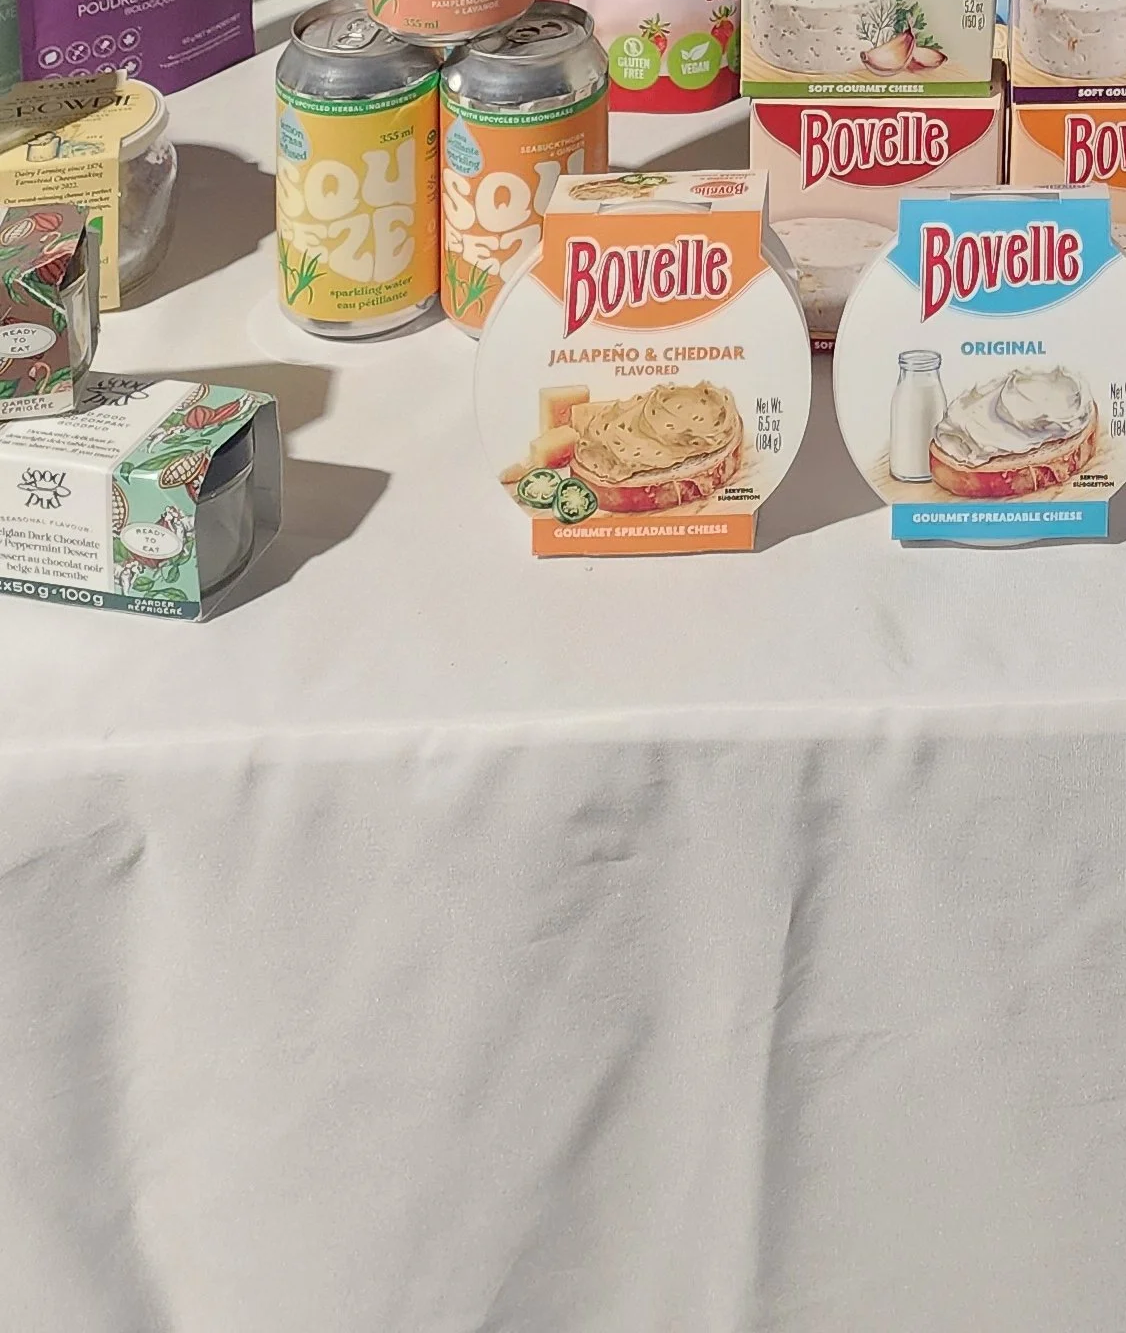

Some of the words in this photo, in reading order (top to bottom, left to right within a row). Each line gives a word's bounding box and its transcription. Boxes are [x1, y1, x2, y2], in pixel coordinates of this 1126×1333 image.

[617, 54, 651, 70] GLUTEN
[680, 59, 710, 75] VEGAN
[623, 67, 645, 80] FREE
[808, 84, 834, 94] SOFT
[835, 84, 887, 94] GOURMET
[888, 84, 925, 94] CHEESE
[1078, 88, 1105, 98] SOFT
[294, 100, 330, 112] UPCYCLED
[331, 105, 364, 113] HERBAL
[365, 93, 417, 111] INGREDIENTS
[479, 115, 520, 124] UPCYCLED
[521, 107, 574, 124] LEMONGRASS
[379, 130, 399, 144] 355
[802, 109, 948, 191] Bovelle
[920, 222, 1083, 323] Bovelle
[329, 282, 384, 299] sparkling
[384, 274, 413, 290] water
[563, 236, 732, 339] Bovelle
[336, 300, 356, 310] eau
[357, 288, 409, 310] pétillante
[11, 345, 31, 353] EAT
[549, 343, 640, 367] JALAPEÑO
[644, 348, 658, 361] &
[662, 346, 745, 361] CHEDDAR
[960, 341, 1047, 356] ORIGINAL
[614, 365, 680, 377] FLAVORED
[2, 398, 45, 408] GARDER
[25, 492, 61, 509] pud
[913, 512, 970, 523] GOURMET
[971, 511, 1041, 522] SPREADABLE
[1042, 511, 1083, 521] CHEESE
[135, 528, 166, 537] READY
[554, 527, 612, 539] GOURMET
[614, 526, 686, 538] SPREADABLE
[687, 524, 728, 535] CHEESE
[27, 531, 52, 543] Dark
[53, 534, 100, 550] Chocolate
[4, 539, 61, 555] Peppermint
[63, 545, 98, 560] Dessert
[142, 545, 160, 554] EAT
[6, 561, 32, 574] belge
[41, 565, 51, 575] la
[52, 568, 89, 582] menthe
[42, 556, 82, 570] chocolat
[83, 562, 104, 573] noir
[37, 585, 49, 599] g
[59, 587, 91, 603] 100
[92, 593, 104, 608] g
[134, 598, 175, 608] GARDER
